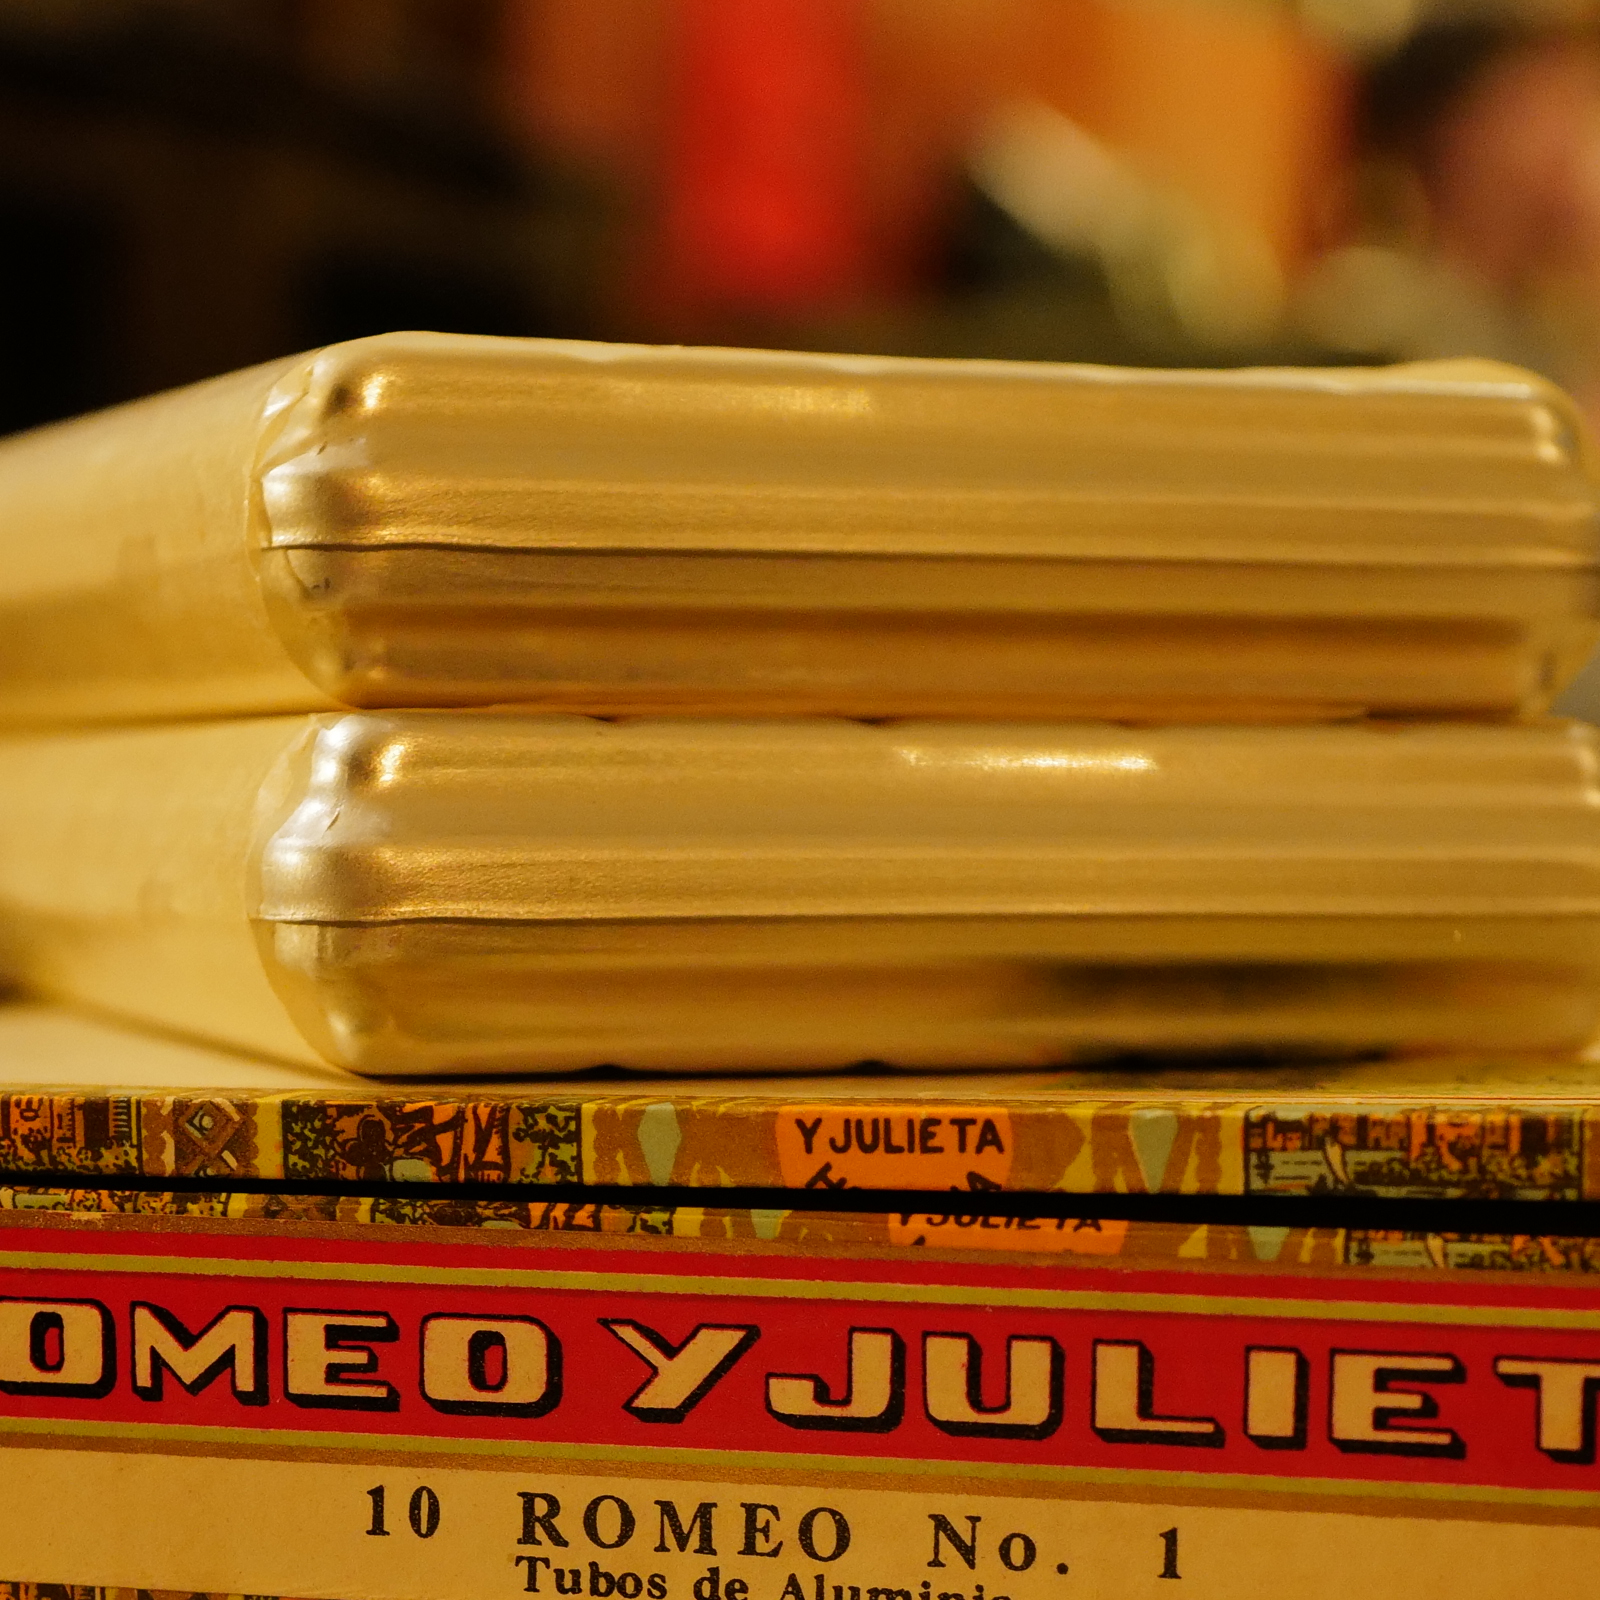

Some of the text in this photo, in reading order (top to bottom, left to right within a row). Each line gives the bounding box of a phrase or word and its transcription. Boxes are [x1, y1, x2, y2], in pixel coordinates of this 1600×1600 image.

[828, 1117, 1005, 1155] JULIETA
[597, 1317, 761, 1425] Y
[365, 1484, 1183, 1580] 10 ROMEO No. 1
[514, 1555, 669, 1600] Tubos
